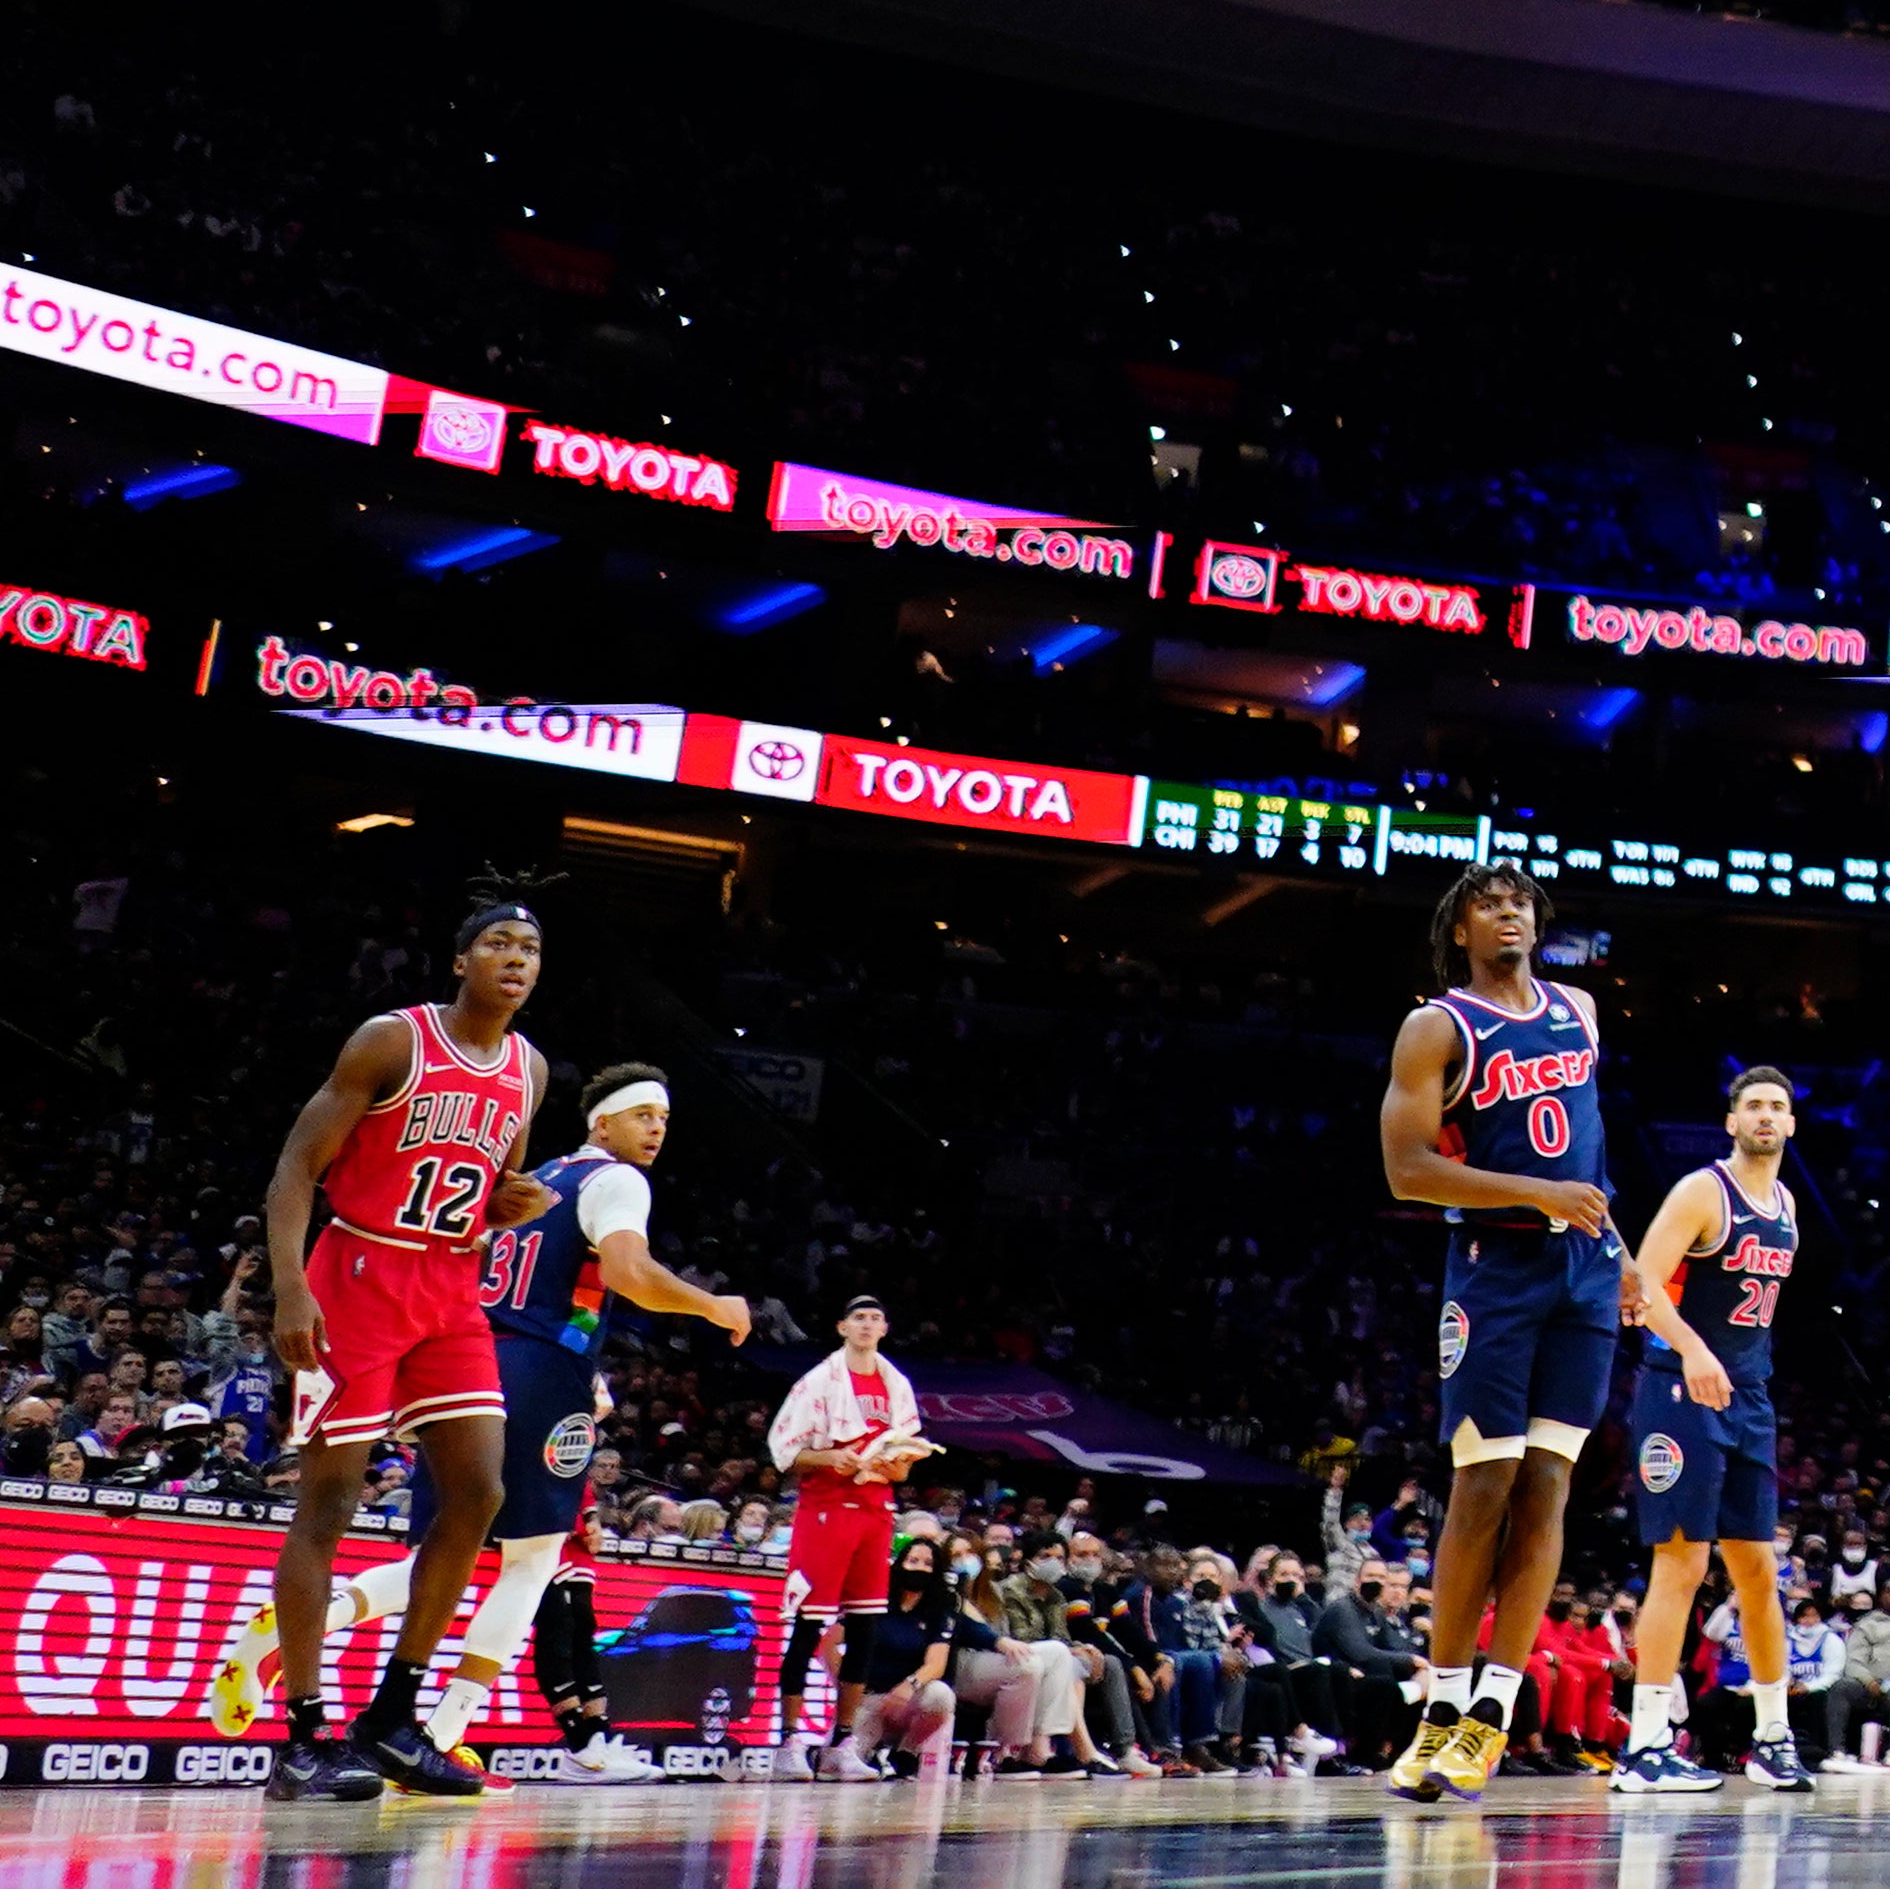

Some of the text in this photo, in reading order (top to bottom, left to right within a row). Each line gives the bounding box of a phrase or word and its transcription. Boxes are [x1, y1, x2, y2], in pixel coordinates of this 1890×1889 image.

[0, 280, 340, 412] toyota.com
[528, 421, 734, 508] TOYOTA
[818, 482, 1135, 579] toyota.com
[1301, 565, 1483, 633] TOYOTA
[1567, 593, 1867, 666] toyota.com
[253, 633, 647, 757] toyota.com
[853, 751, 1075, 824] TOYOTA
[1155, 825, 1366, 868] CHI 39 17 4 10
[1156, 800, 1362, 844] PHI 31 21 3 7
[1612, 866, 1650, 885] WAS
[1472, 1049, 1594, 1111] Sixers
[396, 1091, 523, 1173] BULLS
[1527, 1095, 1570, 1158] 0
[395, 1155, 486, 1238] 12
[478, 1228, 543, 1312] 31
[1722, 1233, 1793, 1278] Sixers
[1728, 1278, 1782, 1328] 20
[0, 1479, 44, 1500] GEICO
[48, 1484, 90, 1504] GEICO
[94, 1488, 136, 1508] GEICO
[138, 1493, 180, 1512] GEICO
[184, 1498, 224, 1517] GEICO
[42, 1744, 149, 1781] GEICO
[174, 1746, 273, 1782] GEICO
[489, 1748, 566, 1781] GEICO
